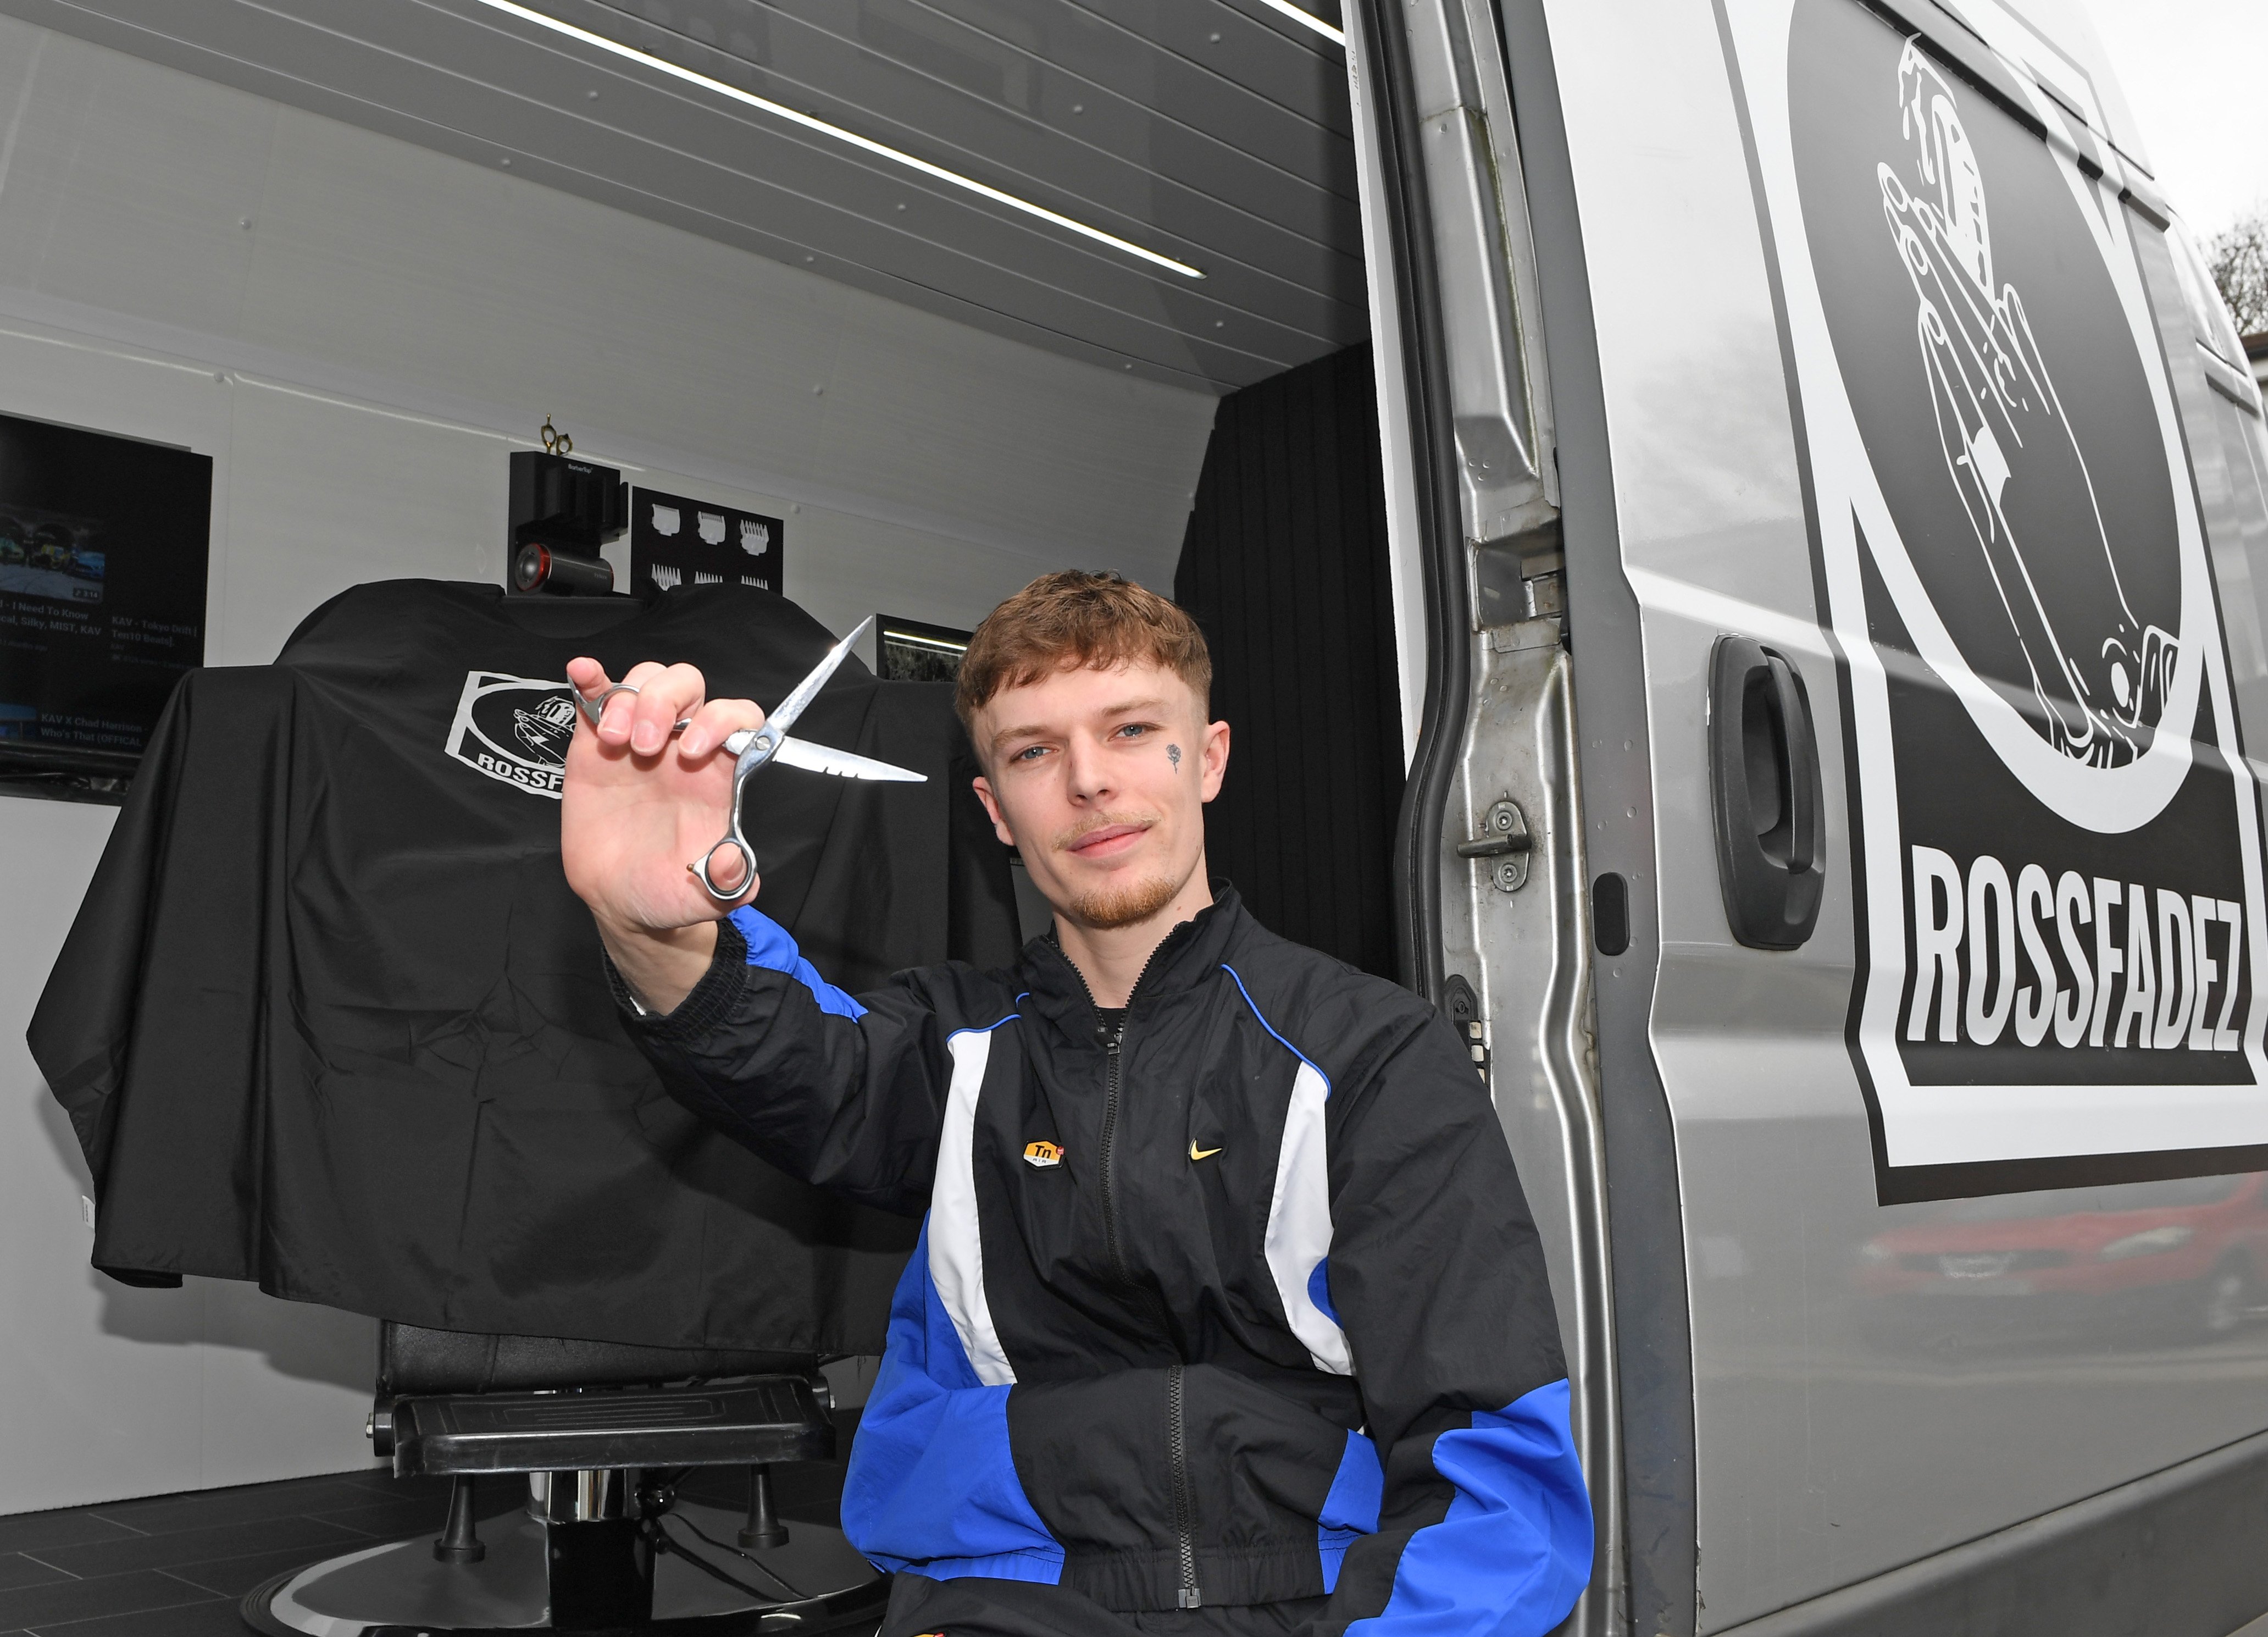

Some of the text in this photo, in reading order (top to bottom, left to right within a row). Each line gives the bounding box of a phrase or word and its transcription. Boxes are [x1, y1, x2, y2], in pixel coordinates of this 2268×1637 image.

[18, 602, 45, 614] Need
[47, 606, 59, 616] To
[62, 609, 88, 620] Know
[21, 617, 47, 631] Silky,
[49, 621, 77, 634] MIST,
[80, 625, 102, 635] KAV
[111, 616, 133, 626] KAV
[141, 619, 169, 633] Tokyo
[41, 714, 63, 725] KAV
[74, 717, 99, 728] Chad
[101, 720, 142, 733] Harrison
[40, 727, 70, 739] Who's
[73, 731, 95, 742] That
[477, 753, 565, 792] ROSSF
[1906, 844, 2241, 1052] ROSSFADEZ
[1035, 1144, 1052, 1159] Tn
